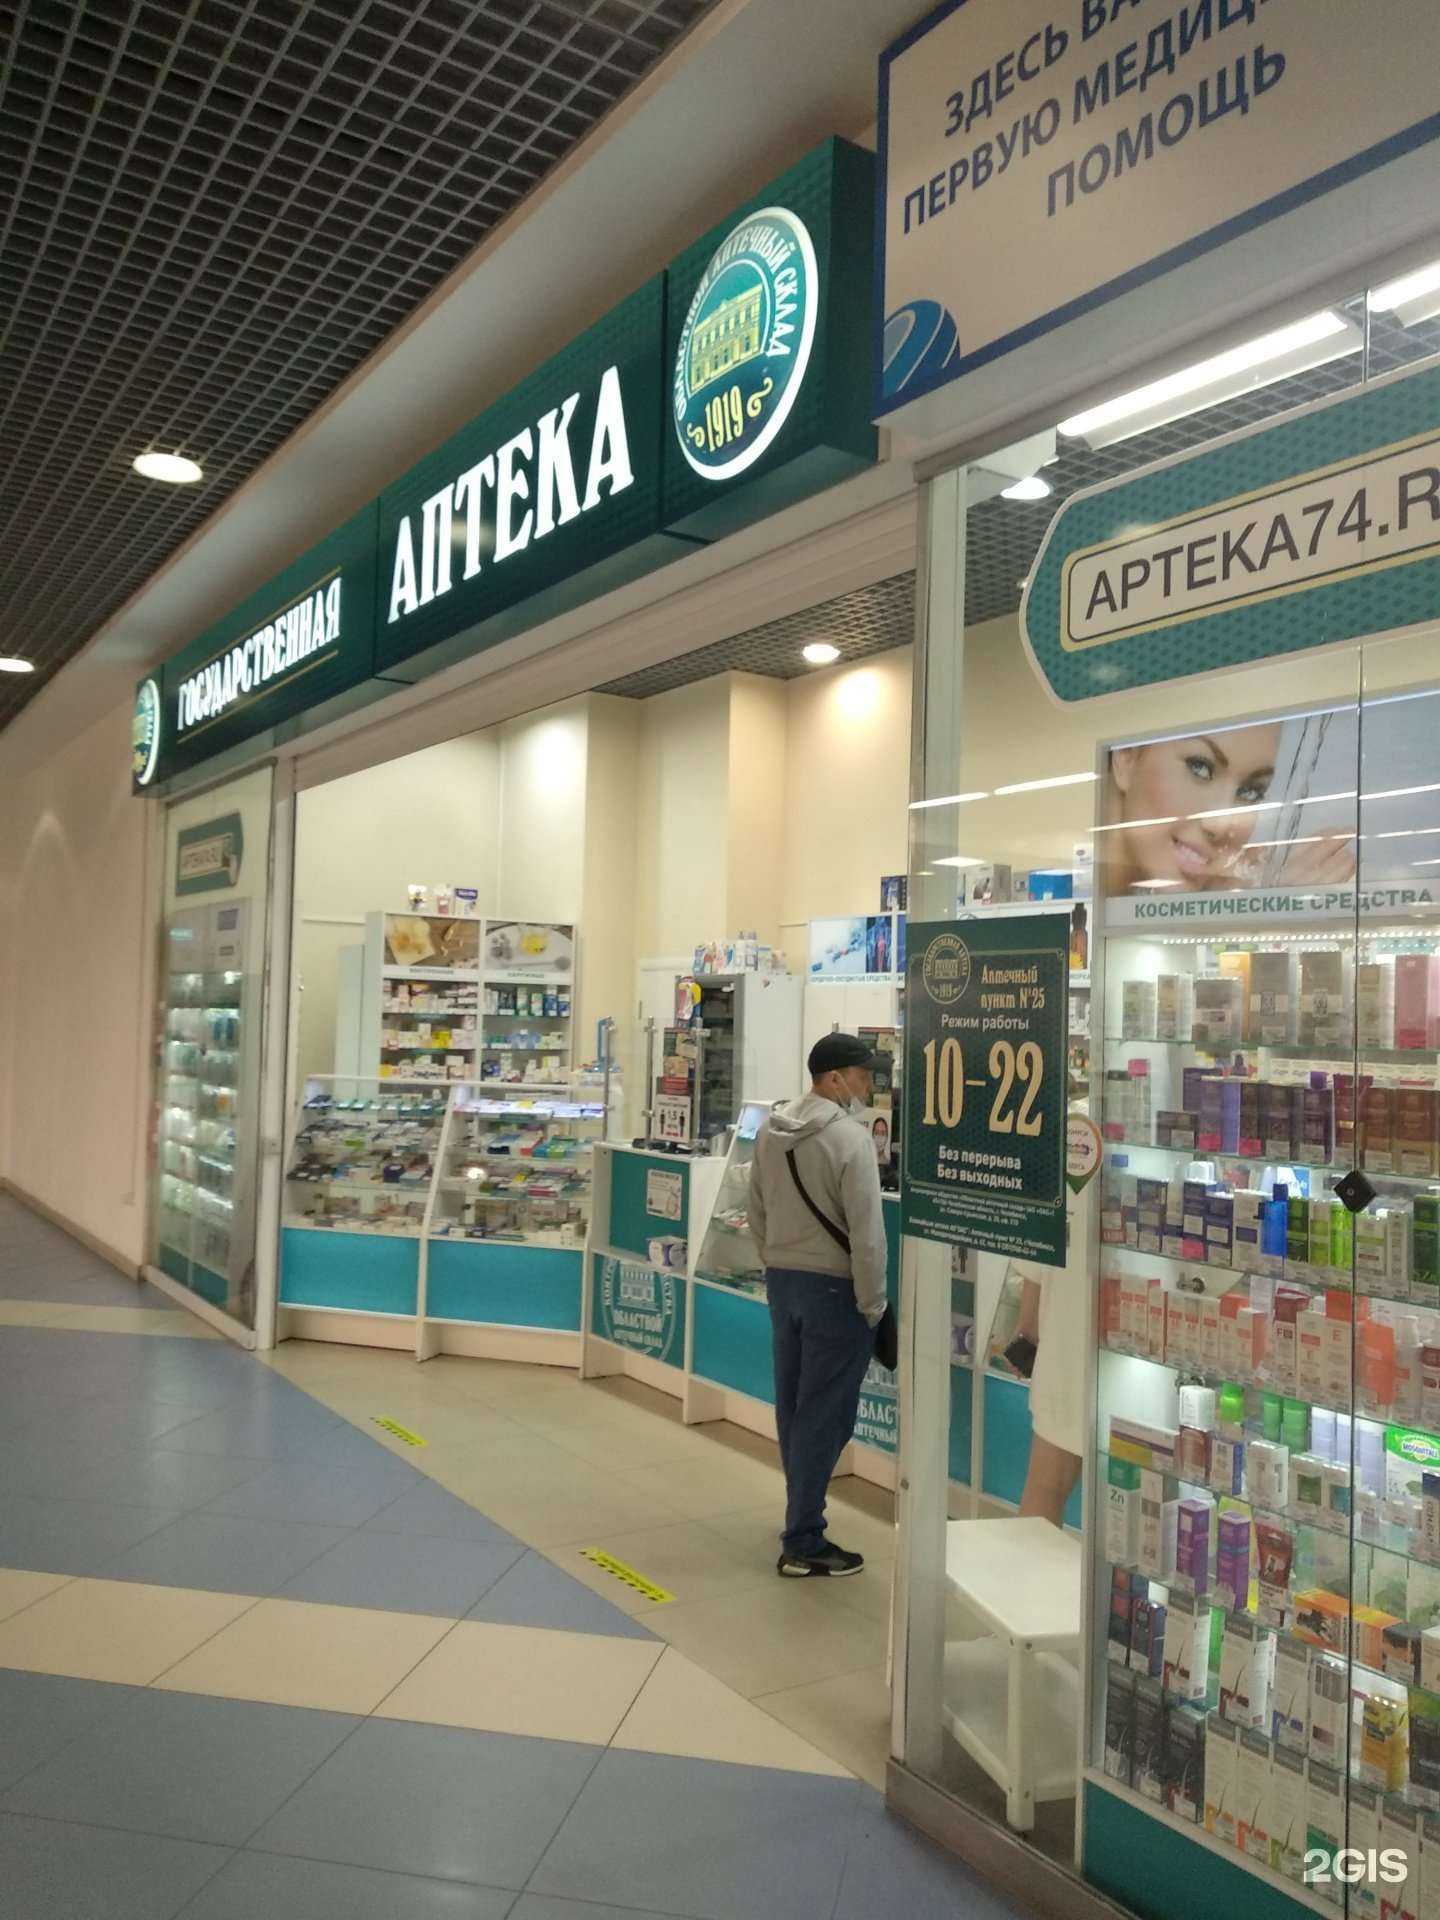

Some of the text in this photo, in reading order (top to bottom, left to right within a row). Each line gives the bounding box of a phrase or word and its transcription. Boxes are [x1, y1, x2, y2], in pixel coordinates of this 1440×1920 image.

[903, 0, 1268, 234] ПЕРВУЮ МЕДИЦ
[944, 23, 1068, 137] ЗДЕСЬ
[1046, 43, 1286, 217] ПОМОЩЬ
[711, 225, 797, 276] АПТЕЧНЫЙ
[766, 266, 799, 358] СКЛАД
[705, 385, 744, 451] 1919
[387, 365, 636, 624] АПТЕКА
[1085, 466, 1440, 620] APTEKA74.R
[177, 577, 342, 730] ГОСУДАРСТВЕННАЯ
[1134, 888, 1433, 918] КОСМЕТИЧЕСКИЕ СРЕДСТВА
[980, 964, 1038, 985] Аптечный
[980, 992, 1016, 1012] пункт
[941, 1013, 1030, 1033] Режим работы
[937, 1163, 1023, 1191] Без выходных
[938, 1145, 1022, 1171] Без перерыва
